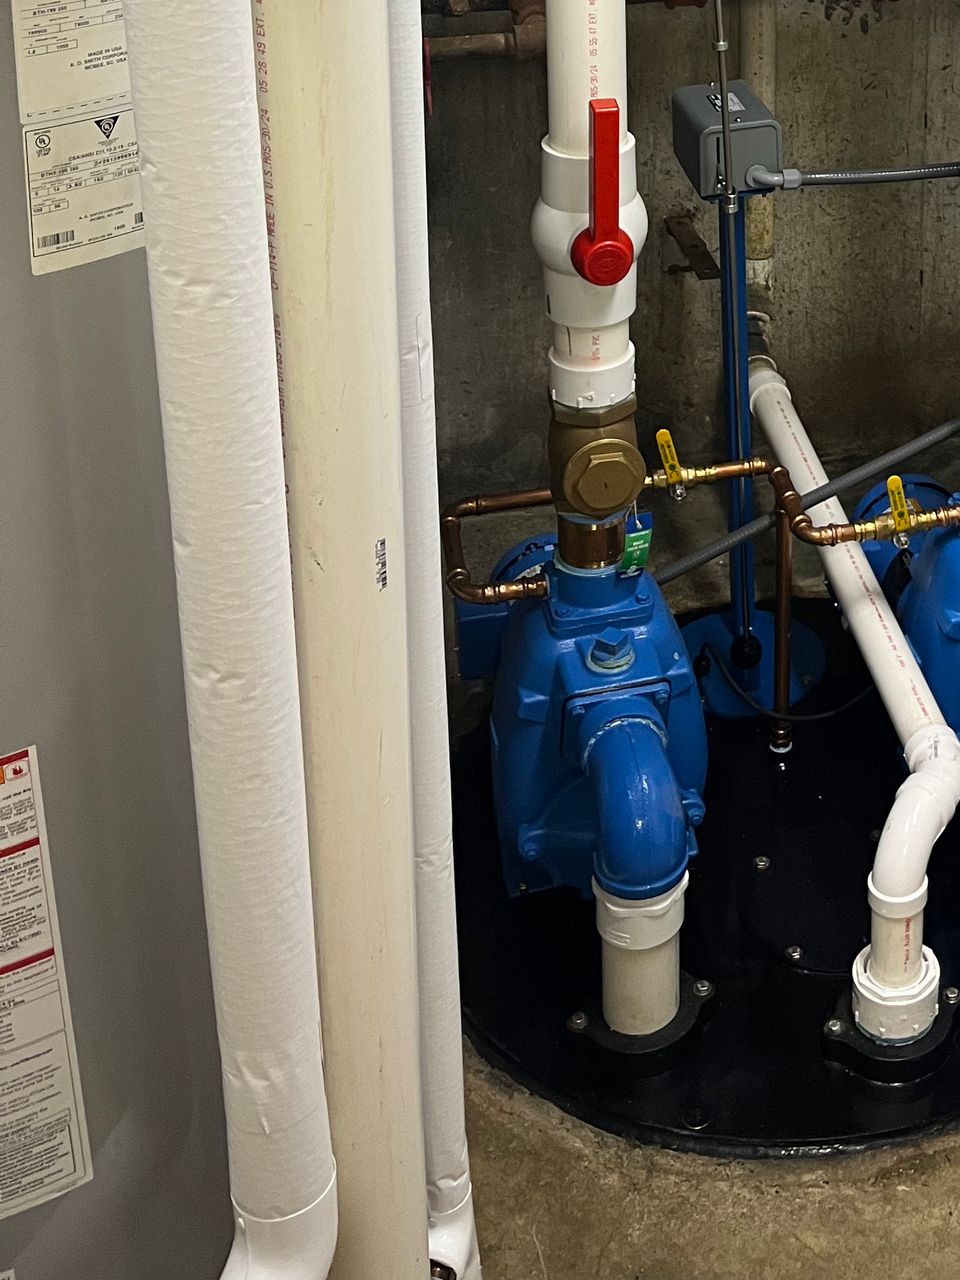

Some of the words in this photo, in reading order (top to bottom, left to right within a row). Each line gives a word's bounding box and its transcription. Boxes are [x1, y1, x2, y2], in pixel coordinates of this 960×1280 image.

[110, 45, 122, 53] USA
[84, 57, 101, 65] SMITH
[265, 194, 274, 207] IN
[266, 211, 275, 238] MADE
